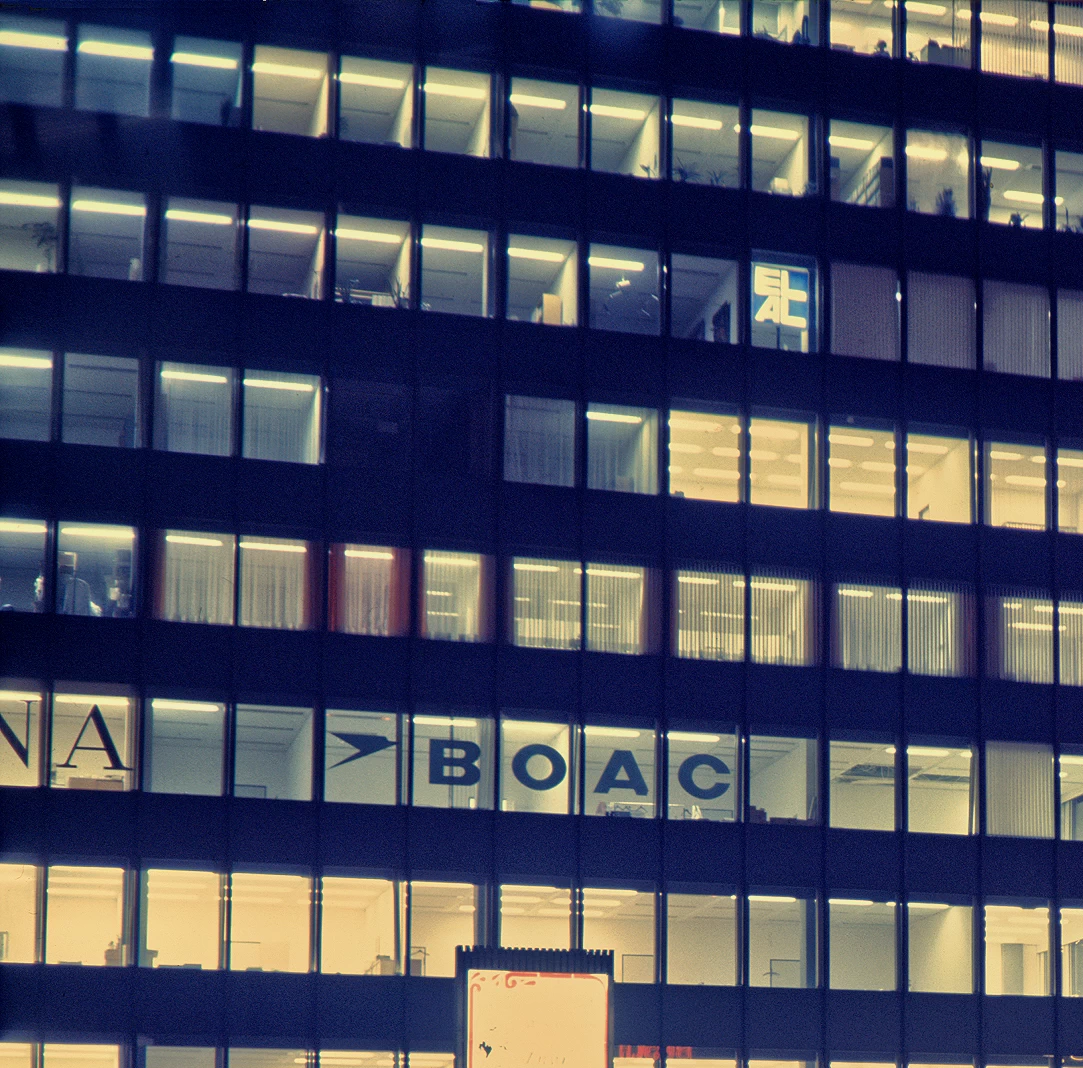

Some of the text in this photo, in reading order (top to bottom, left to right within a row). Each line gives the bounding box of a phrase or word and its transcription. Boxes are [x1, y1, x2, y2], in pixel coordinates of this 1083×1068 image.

[754, 266, 808, 302] EL
[754, 295, 808, 328] AL
[428, 739, 731, 800] BOAC
